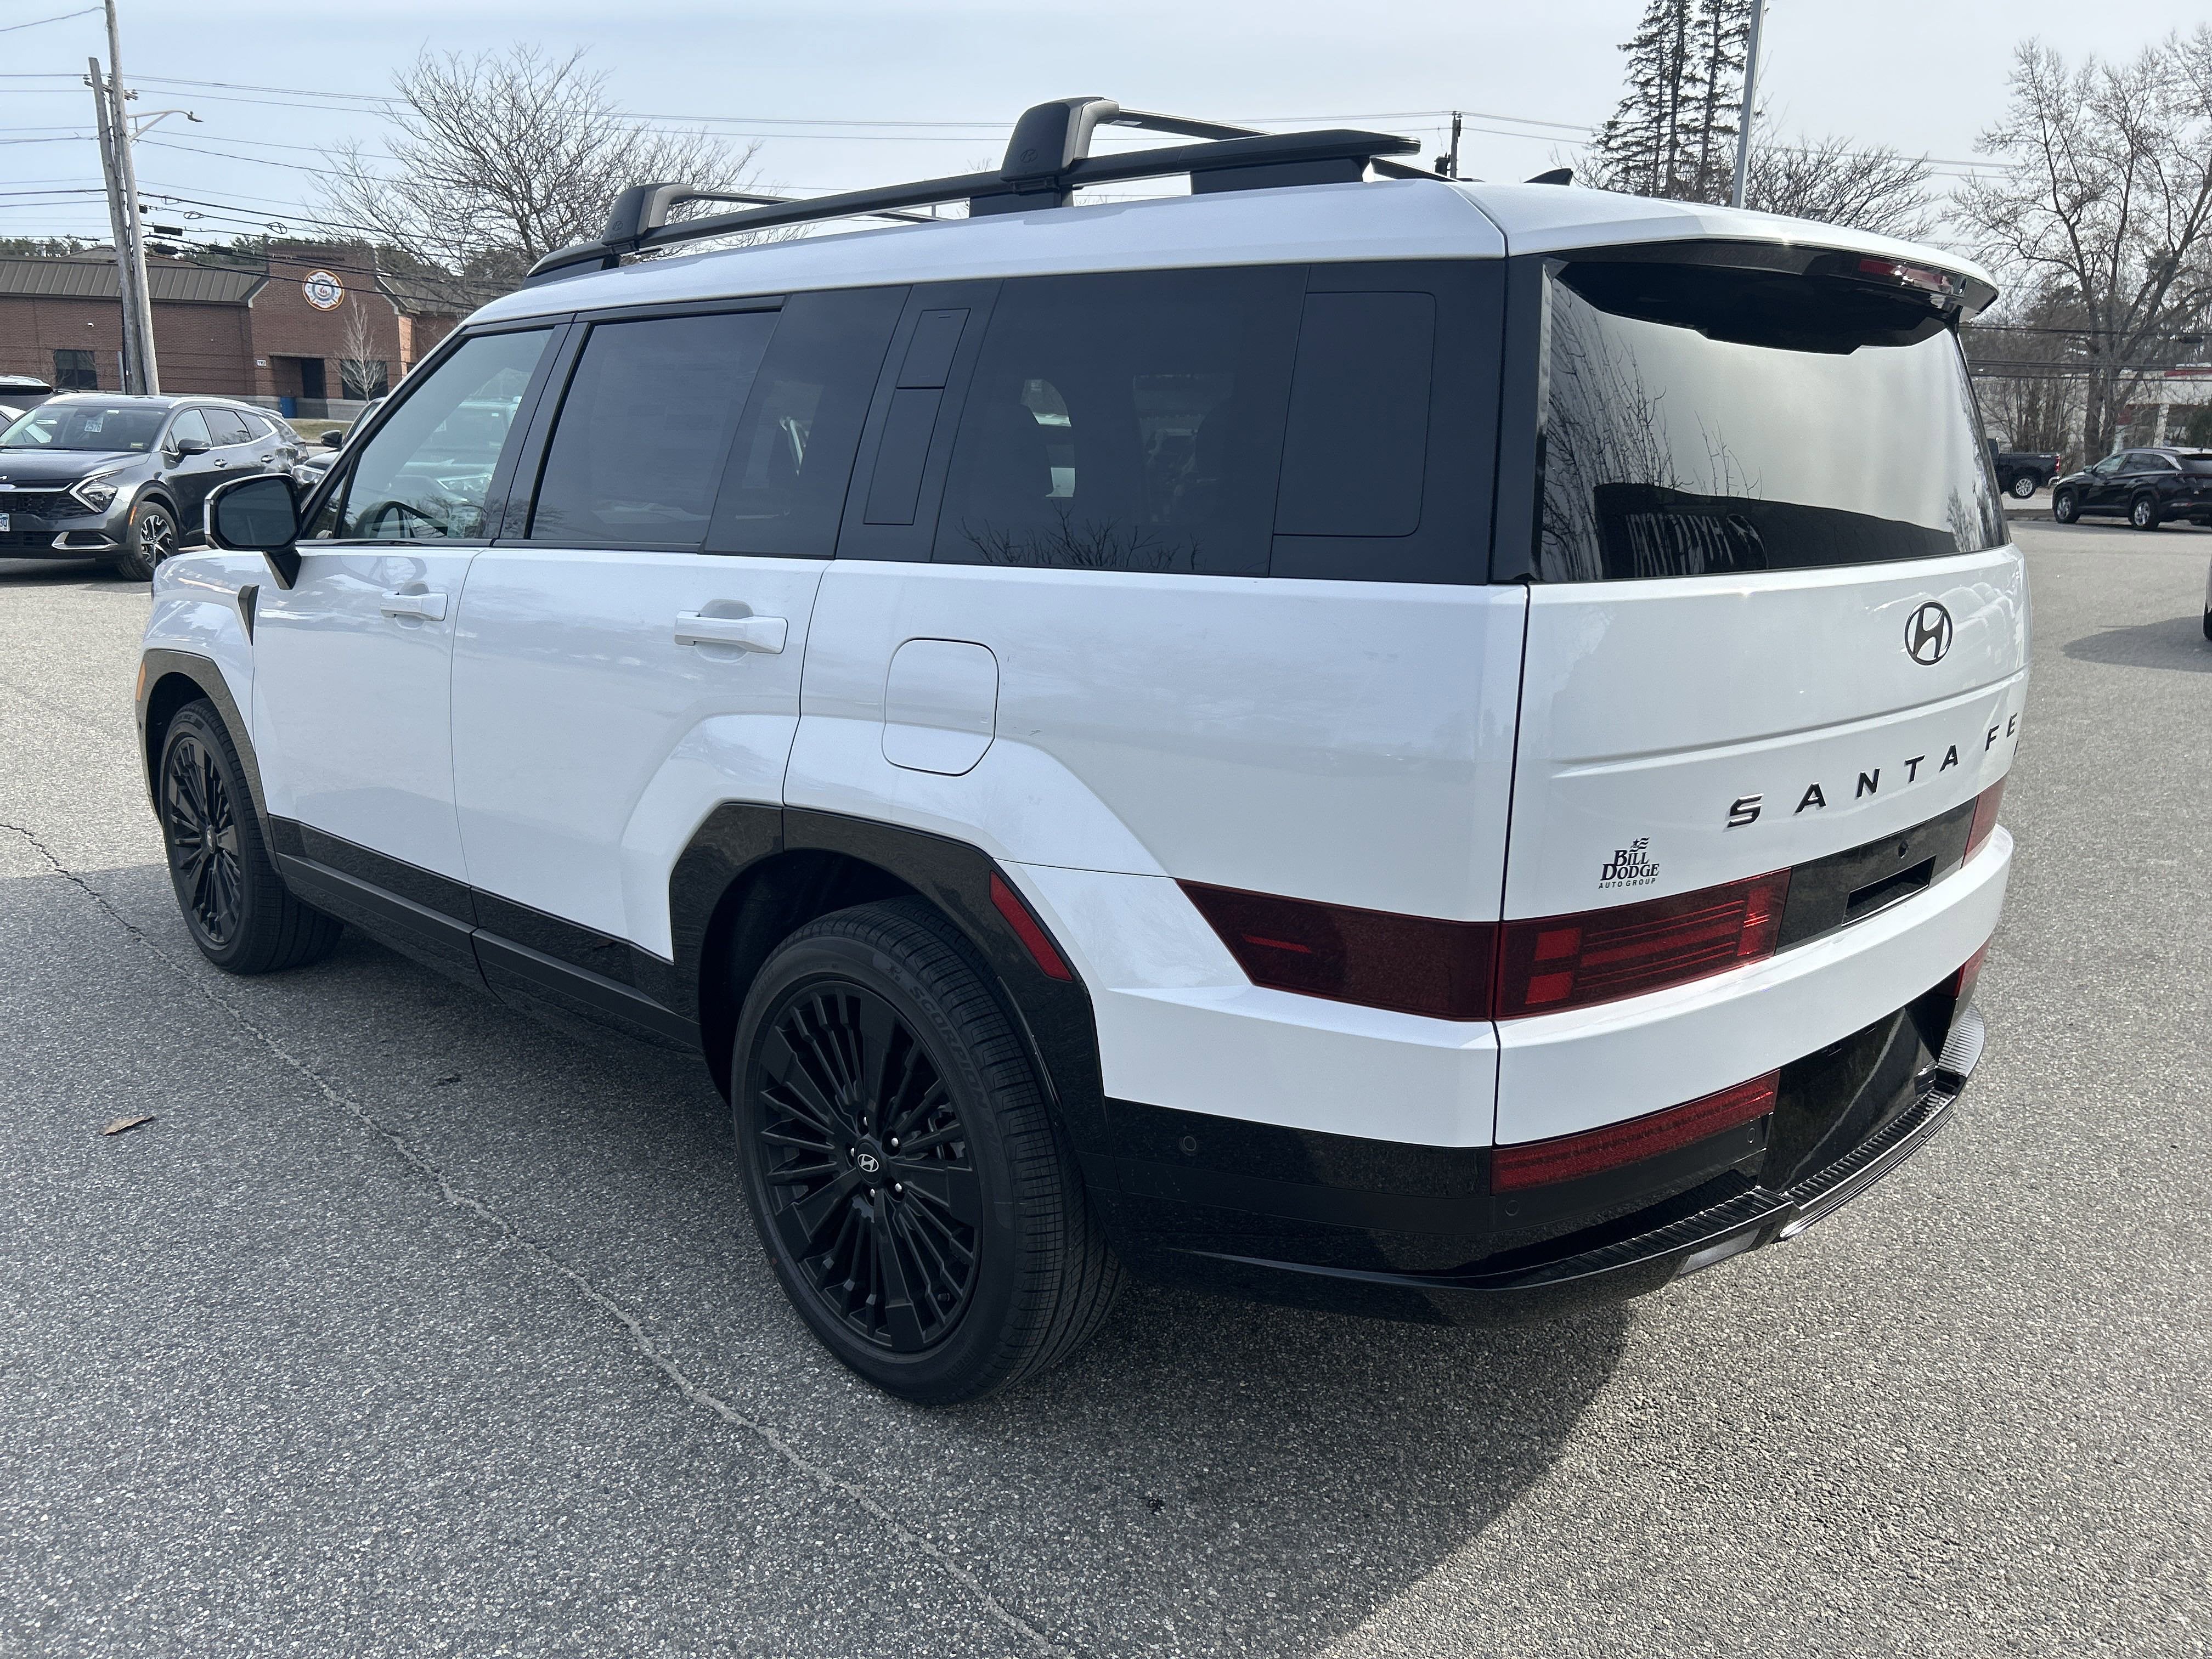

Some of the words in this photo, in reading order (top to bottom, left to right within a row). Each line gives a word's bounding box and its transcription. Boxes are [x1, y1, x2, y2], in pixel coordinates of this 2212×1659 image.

[1726, 744, 1959, 828] SANTA
[1985, 712, 2018, 752] FE
[1614, 850, 1649, 867] BILL
[1600, 864, 1660, 881] DODGE
[1626, 878, 1656, 887] GROUP
[909, 985, 989, 1109] SCORPION
